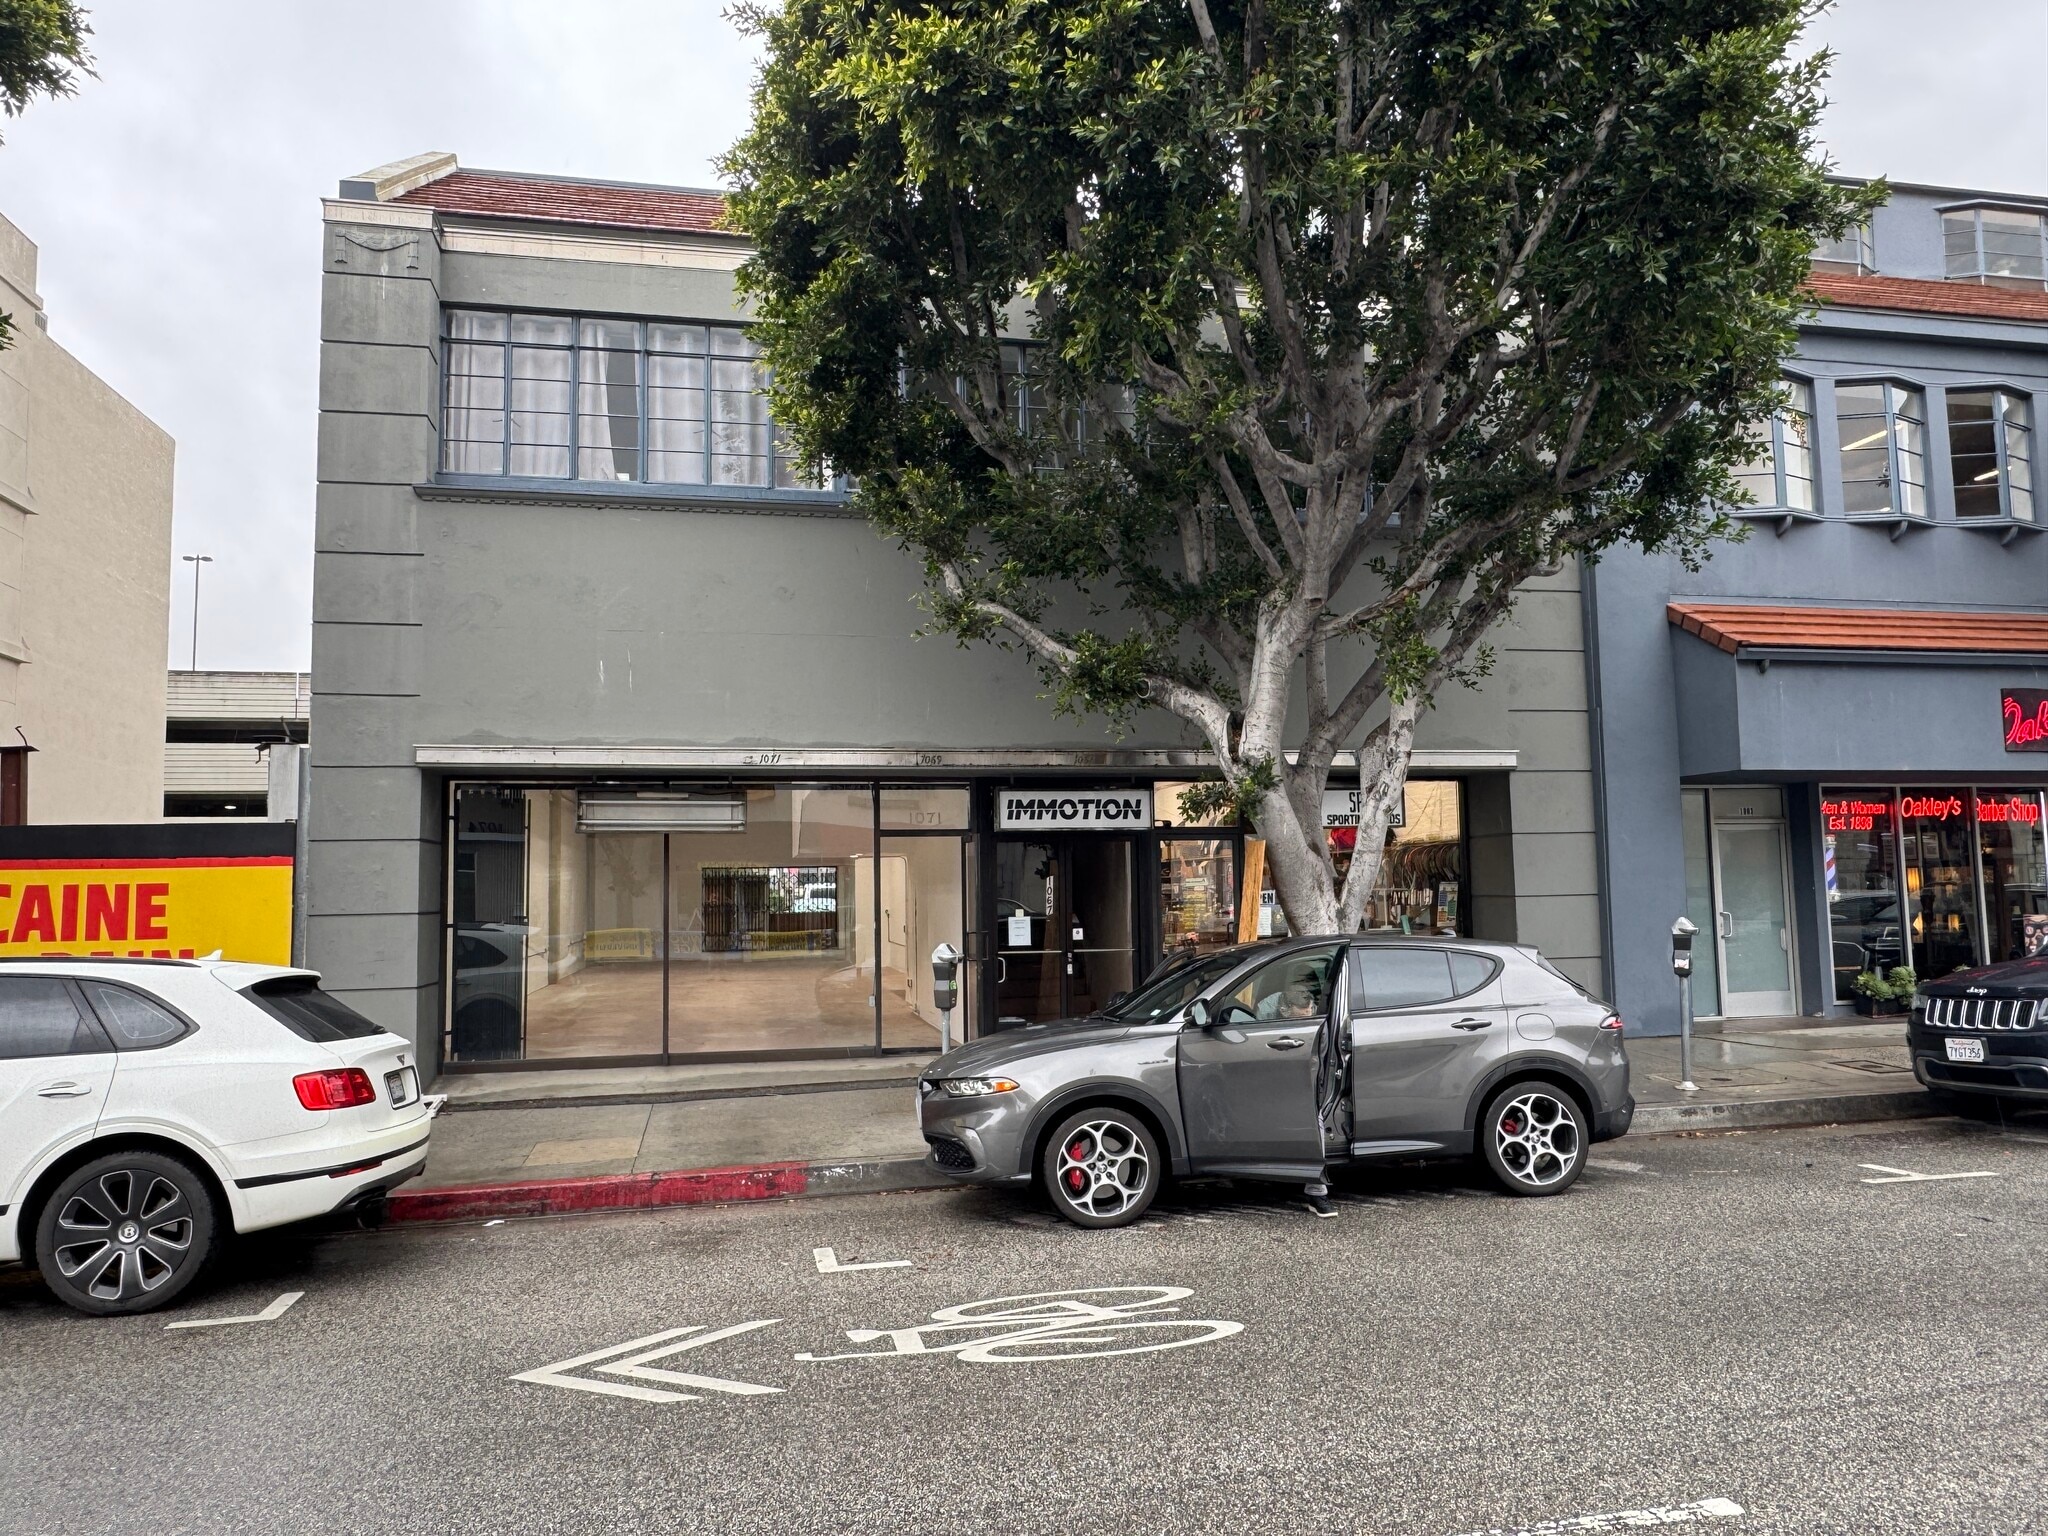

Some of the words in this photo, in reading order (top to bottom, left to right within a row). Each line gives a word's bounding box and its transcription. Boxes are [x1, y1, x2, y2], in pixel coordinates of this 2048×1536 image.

[759, 754, 781, 764] 1071
[920, 755, 942, 765] 1069
[1007, 799, 1142, 820] IMMOTION
[1840, 801, 1848, 814] &
[1851, 801, 1886, 814] Women
[1901, 796, 1962, 820] Oakley's
[1977, 798, 2009, 822] Barber
[2011, 797, 2038, 827] Shop
[909, 812, 942, 825] 1071
[1327, 814, 1360, 825] SPORTI
[1260, 892, 1274, 904] EN
